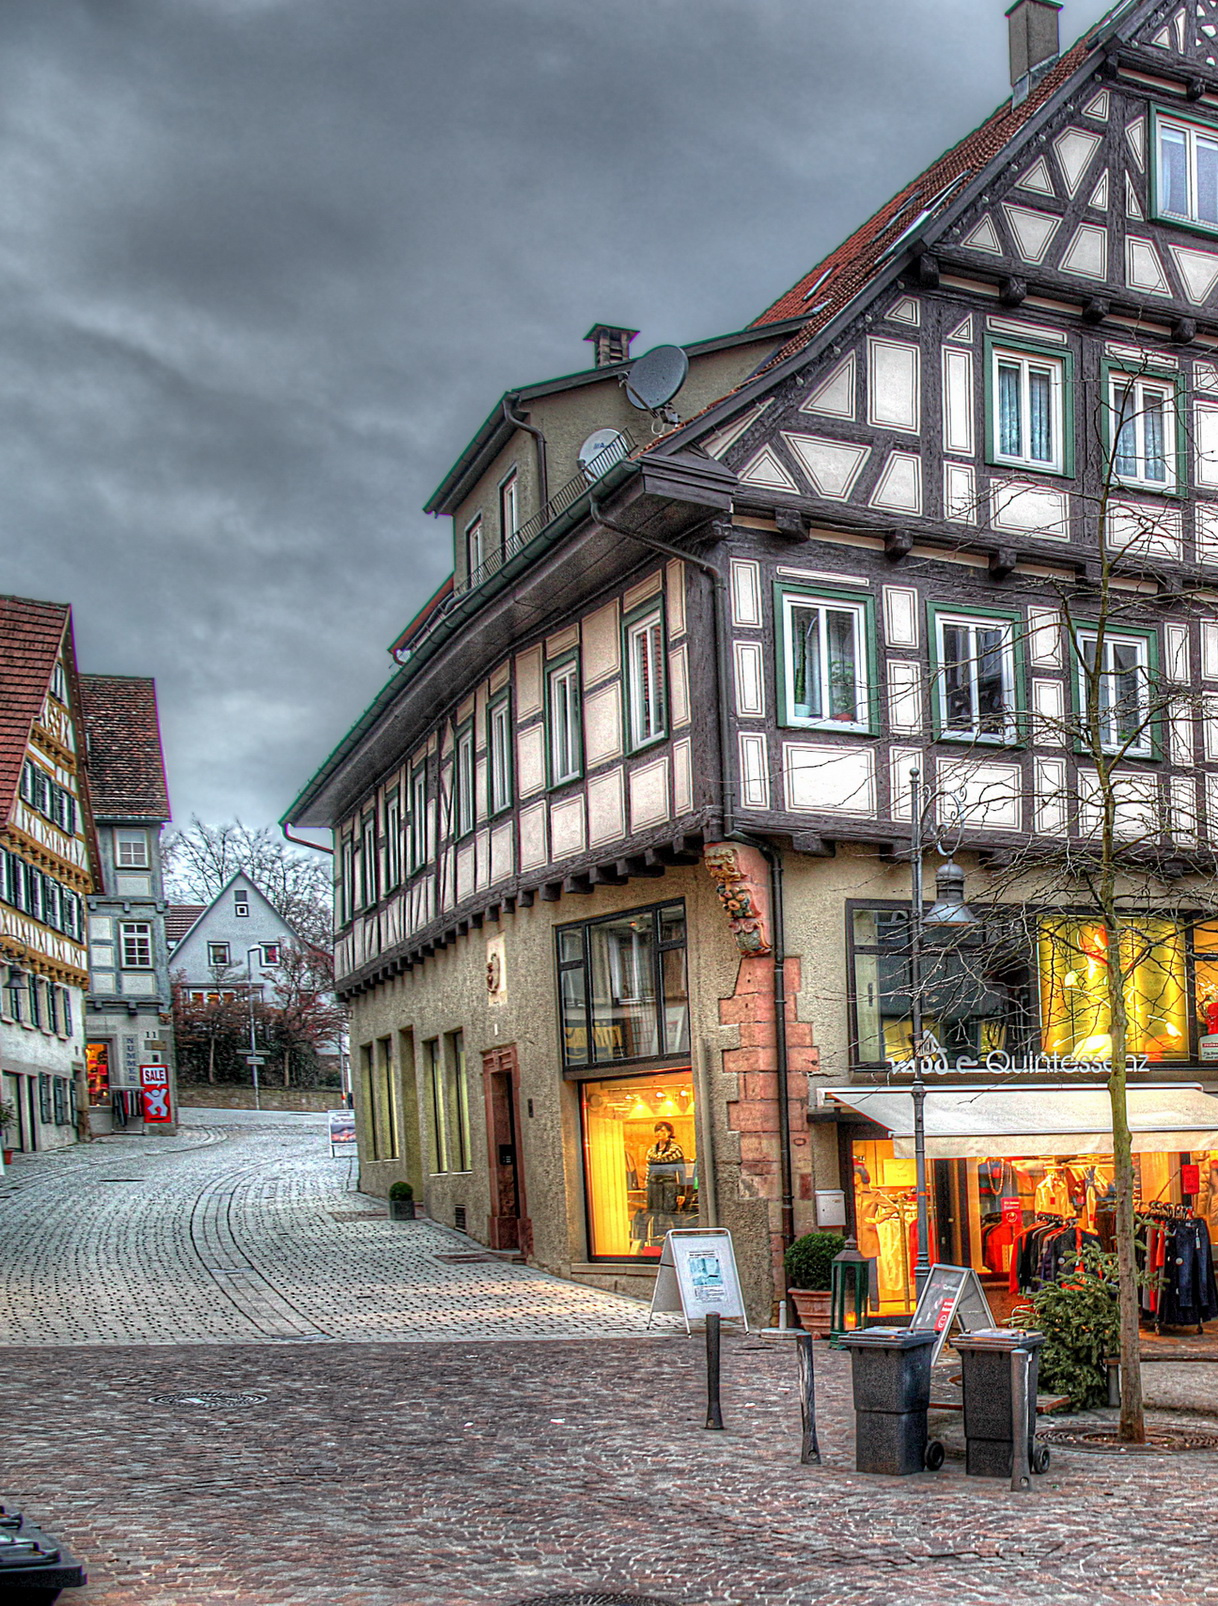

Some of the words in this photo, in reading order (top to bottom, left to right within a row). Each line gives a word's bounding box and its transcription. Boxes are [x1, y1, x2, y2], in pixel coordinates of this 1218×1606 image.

[145, 1031, 157, 1039] 11
[126, 1037, 138, 1081] NUMMER
[986, 1050, 1149, 1074] Quintessenz
[144, 1070, 165, 1081] SALE
